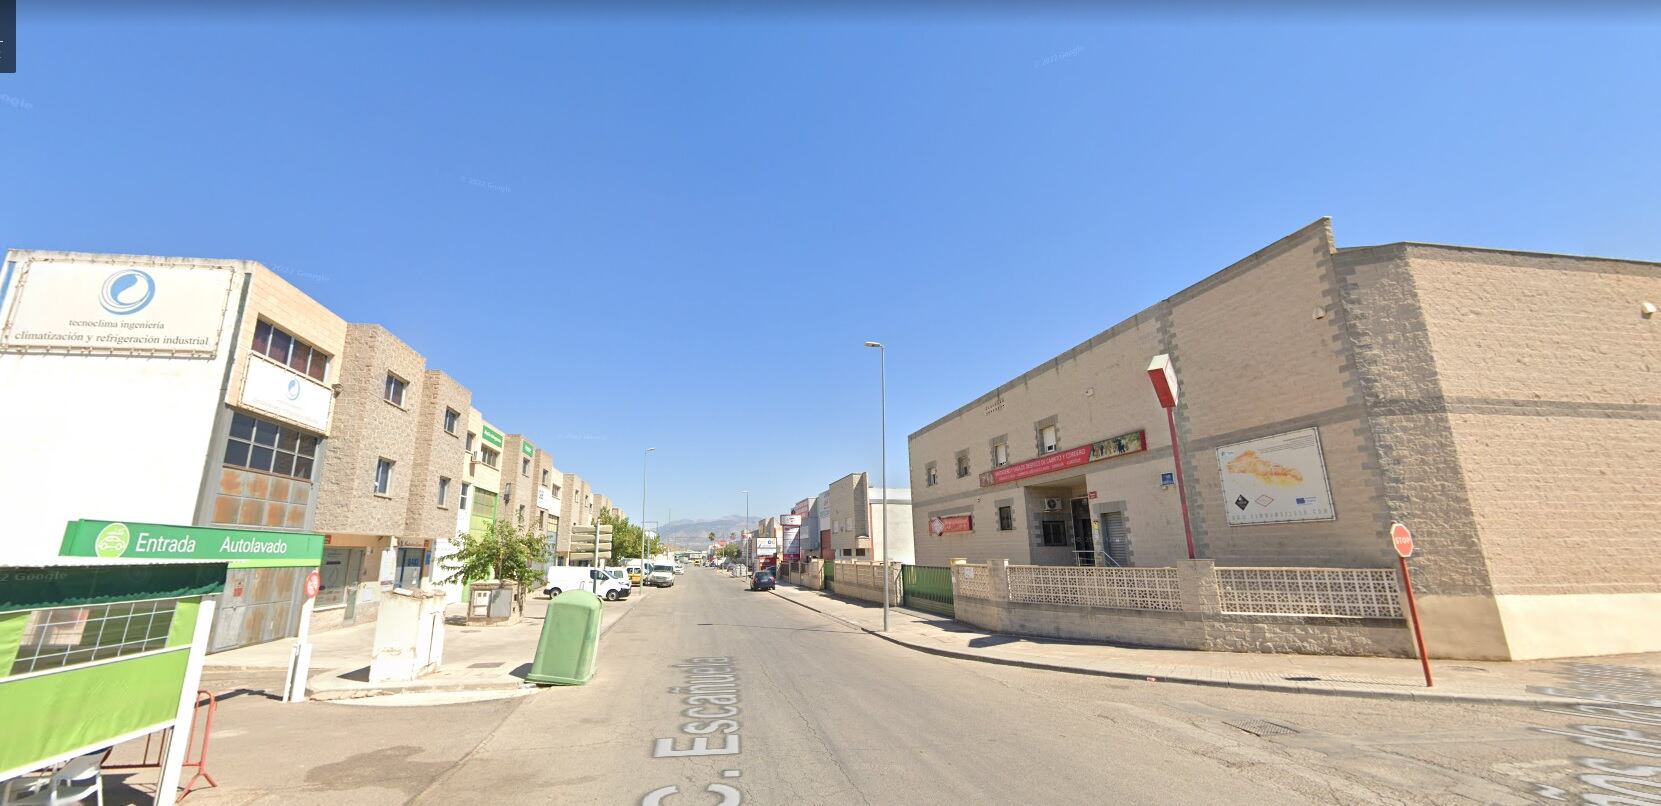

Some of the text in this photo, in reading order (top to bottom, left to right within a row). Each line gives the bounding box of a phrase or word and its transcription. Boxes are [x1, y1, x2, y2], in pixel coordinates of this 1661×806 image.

[68, 319, 165, 330] tecnoclima ingeniería
[14, 331, 210, 346] climatización y refrigeración industrial
[135, 532, 288, 554] Entrada Autolavado
[1394, 536, 1411, 546] STOP
